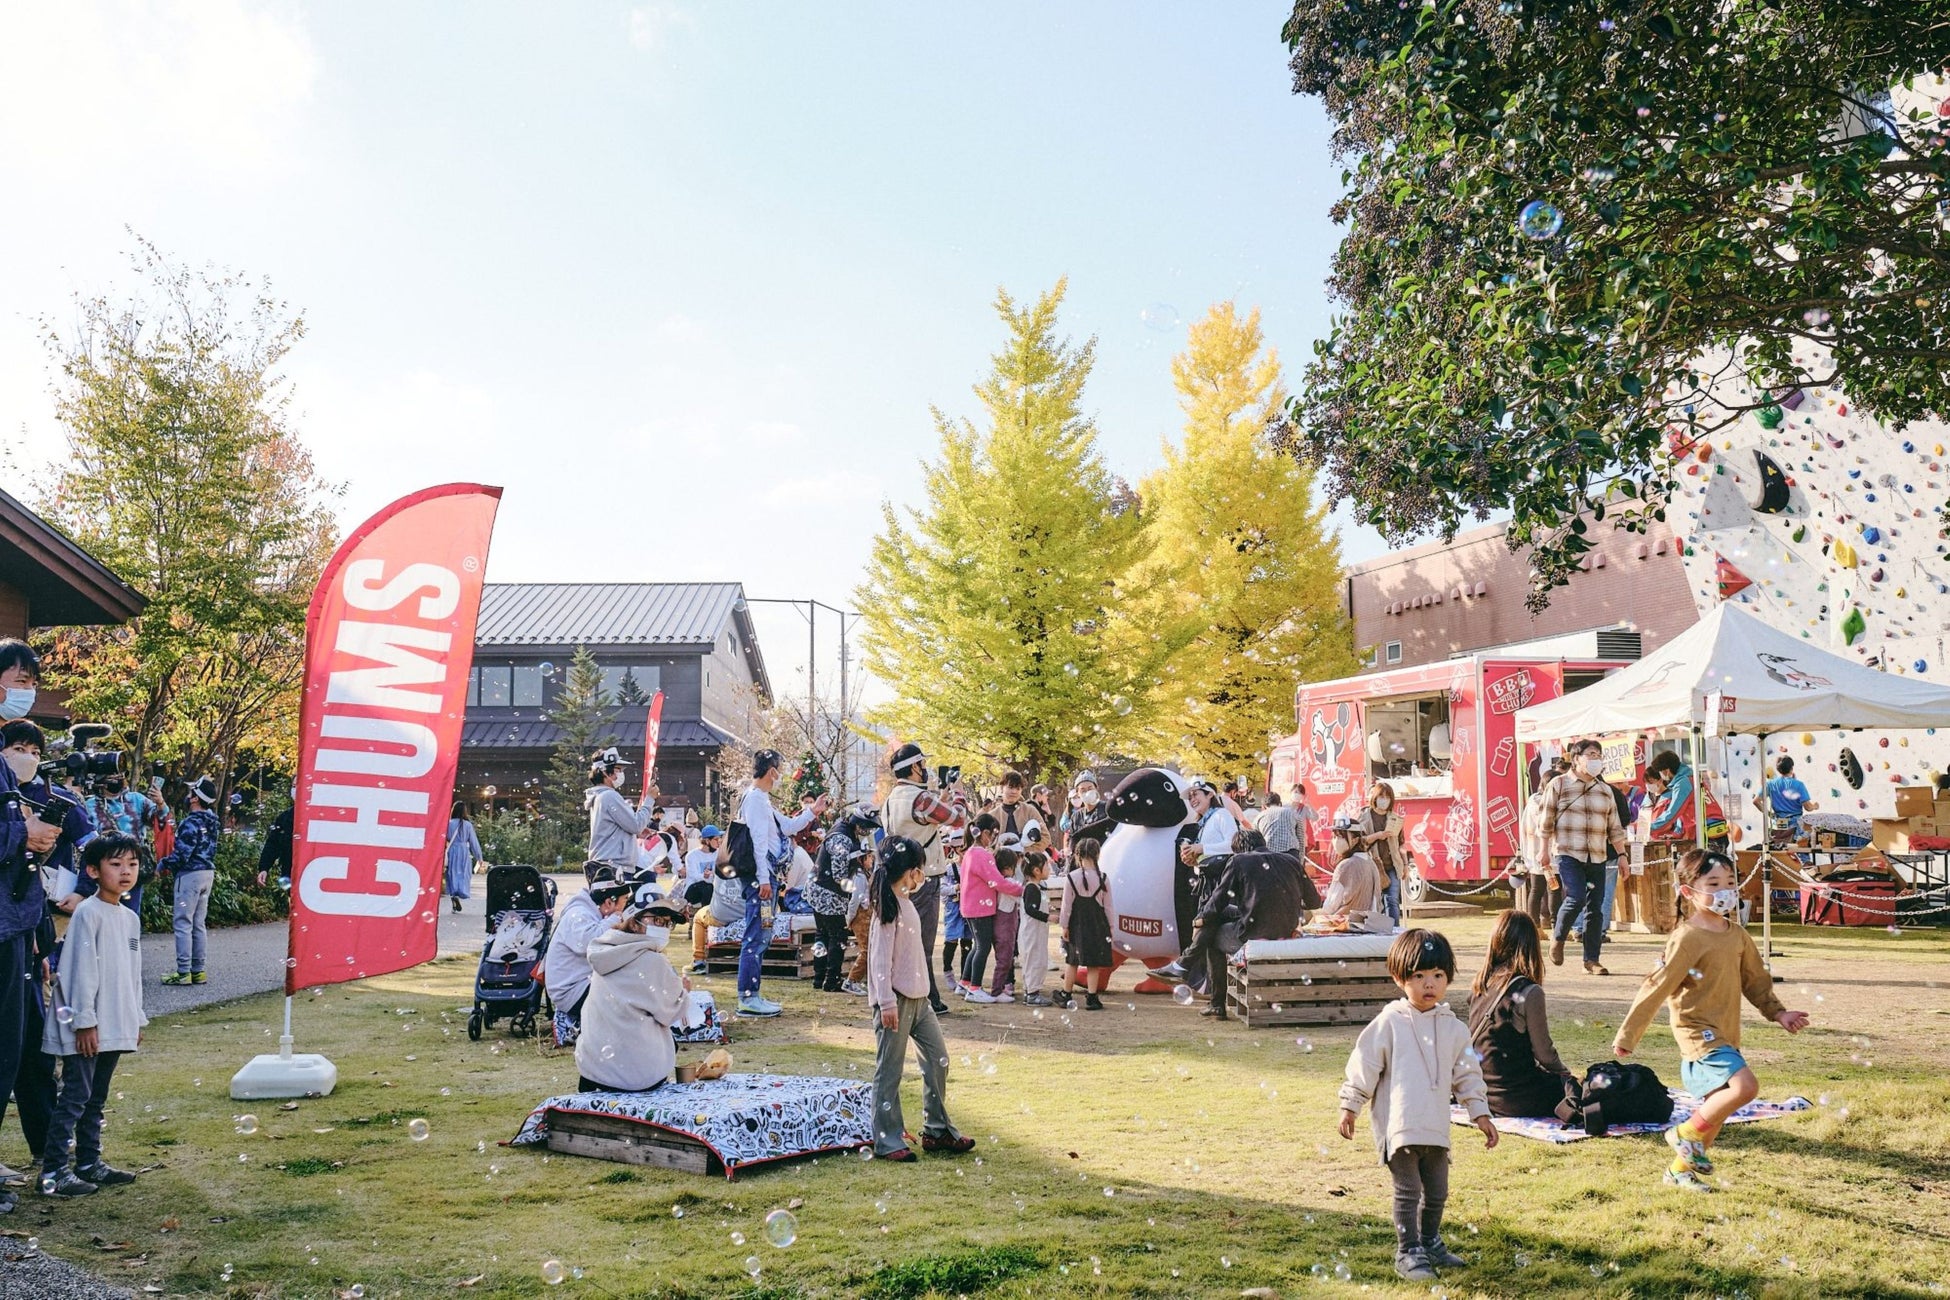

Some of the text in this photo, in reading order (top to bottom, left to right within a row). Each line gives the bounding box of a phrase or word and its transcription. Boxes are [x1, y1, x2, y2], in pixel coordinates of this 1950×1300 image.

[300, 558, 461, 919] CHUMS
[1603, 743, 1630, 760] RDER
[1121, 918, 1160, 934] CHUMS
